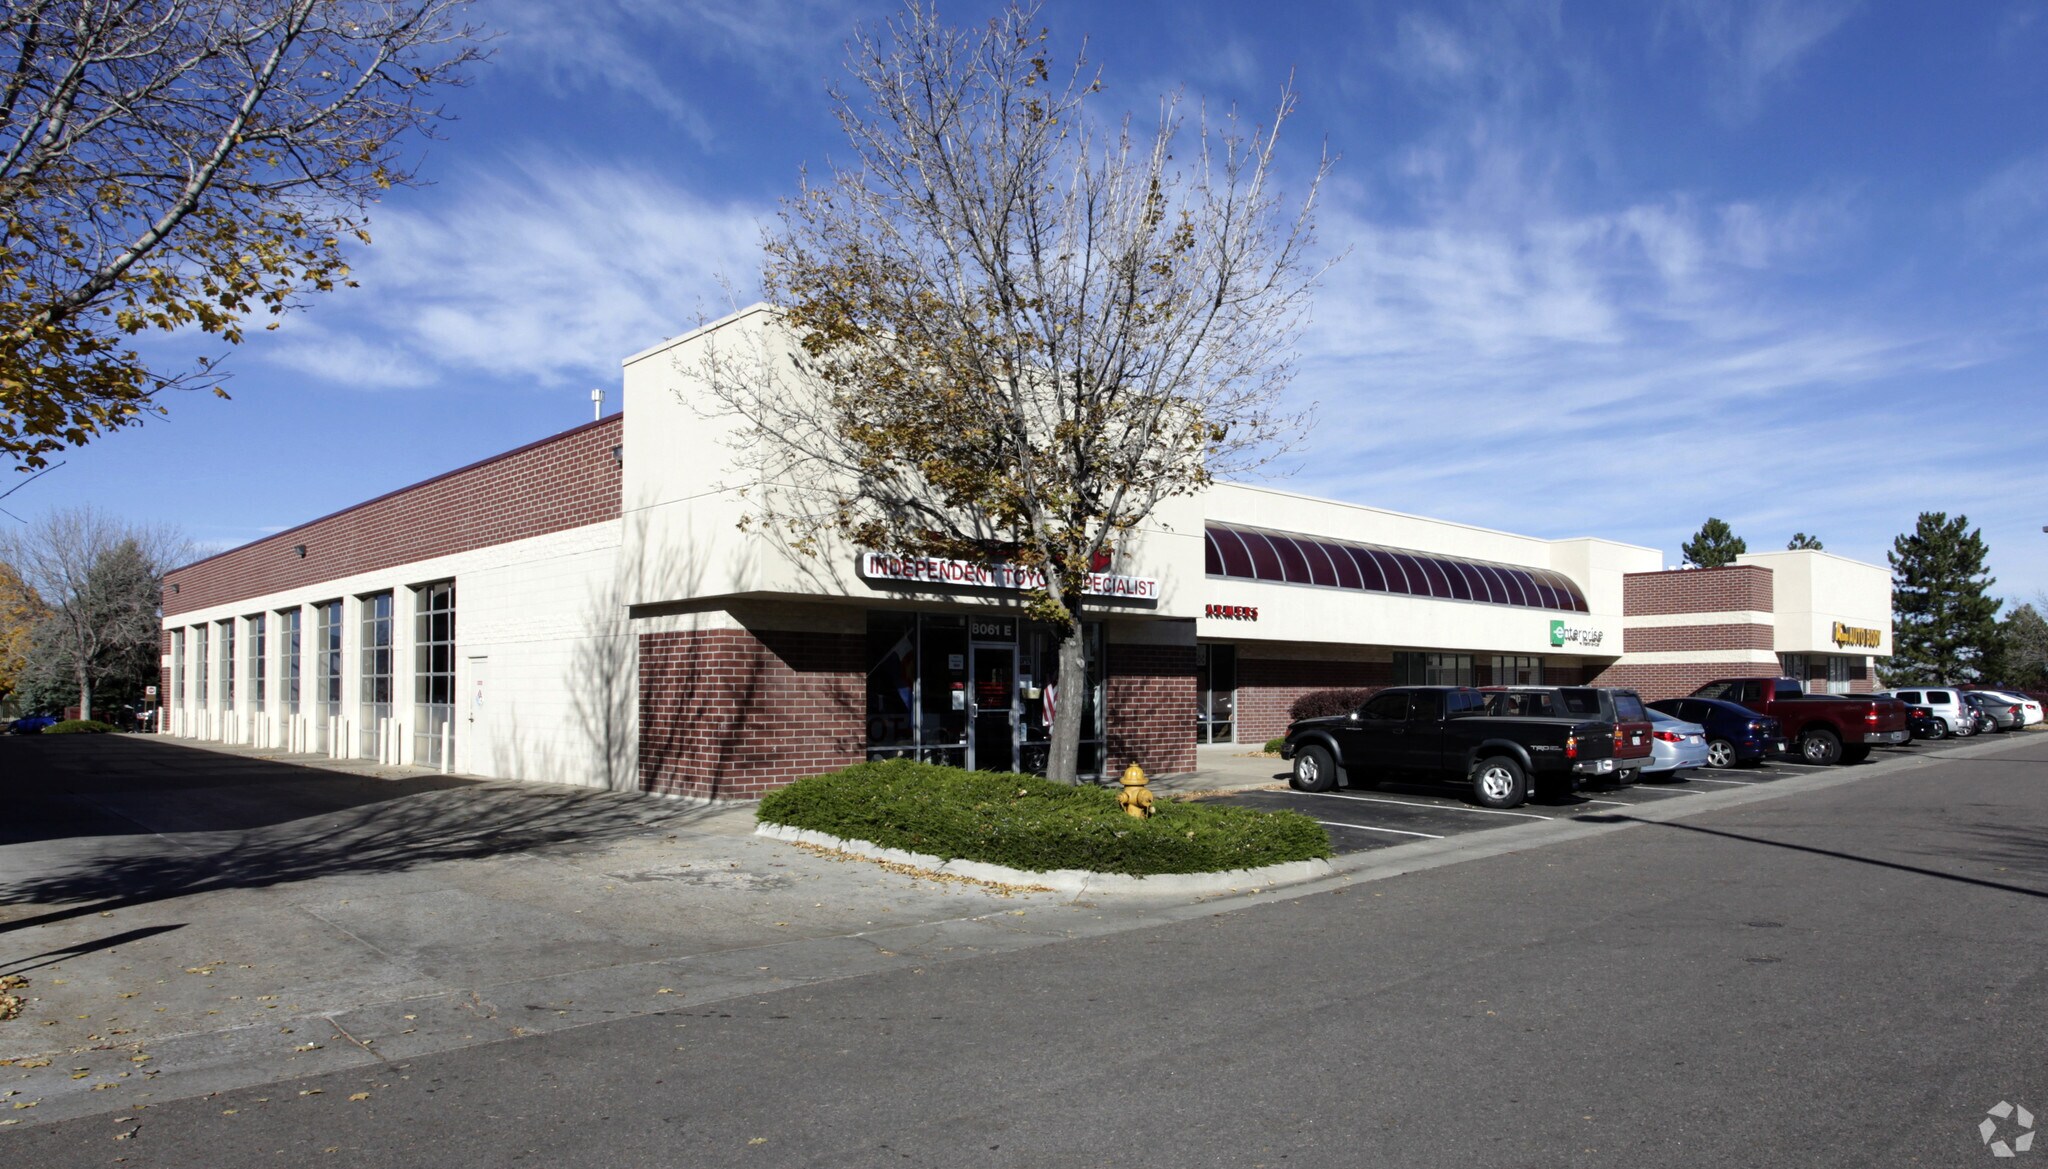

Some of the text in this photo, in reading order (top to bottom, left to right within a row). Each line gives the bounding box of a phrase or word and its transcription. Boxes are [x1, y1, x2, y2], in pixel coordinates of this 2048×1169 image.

[869, 555, 1155, 597] INDEPENDENT TOYO PECIALIST
[1204, 603, 1259, 620] ARMERS
[972, 622, 1012, 636] 8061 E
[1554, 625, 1604, 641] enterprise
